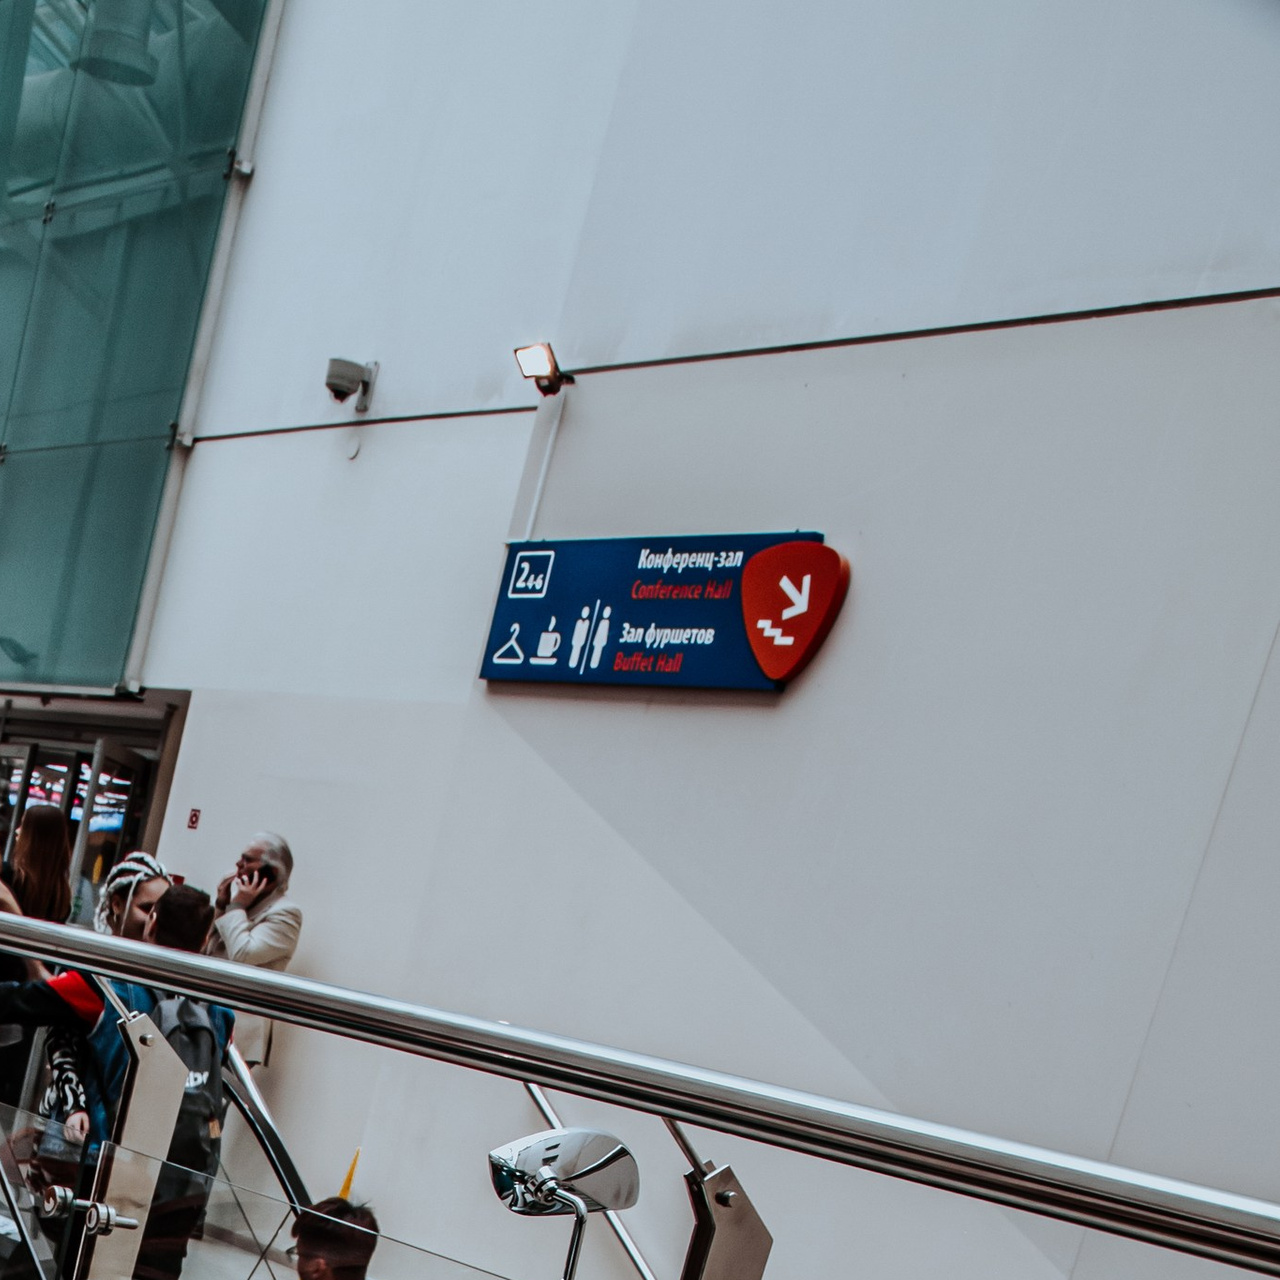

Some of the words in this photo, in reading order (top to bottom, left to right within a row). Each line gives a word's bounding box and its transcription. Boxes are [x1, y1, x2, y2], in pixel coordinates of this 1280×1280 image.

[638, 548, 744, 574] Конференц-зал
[631, 580, 702, 599] Conference
[704, 580, 733, 599] Hall
[619, 622, 644, 643] Зал
[645, 622, 715, 649] фуршетов
[613, 652, 654, 672] Buffet
[655, 652, 683, 672] Hall
